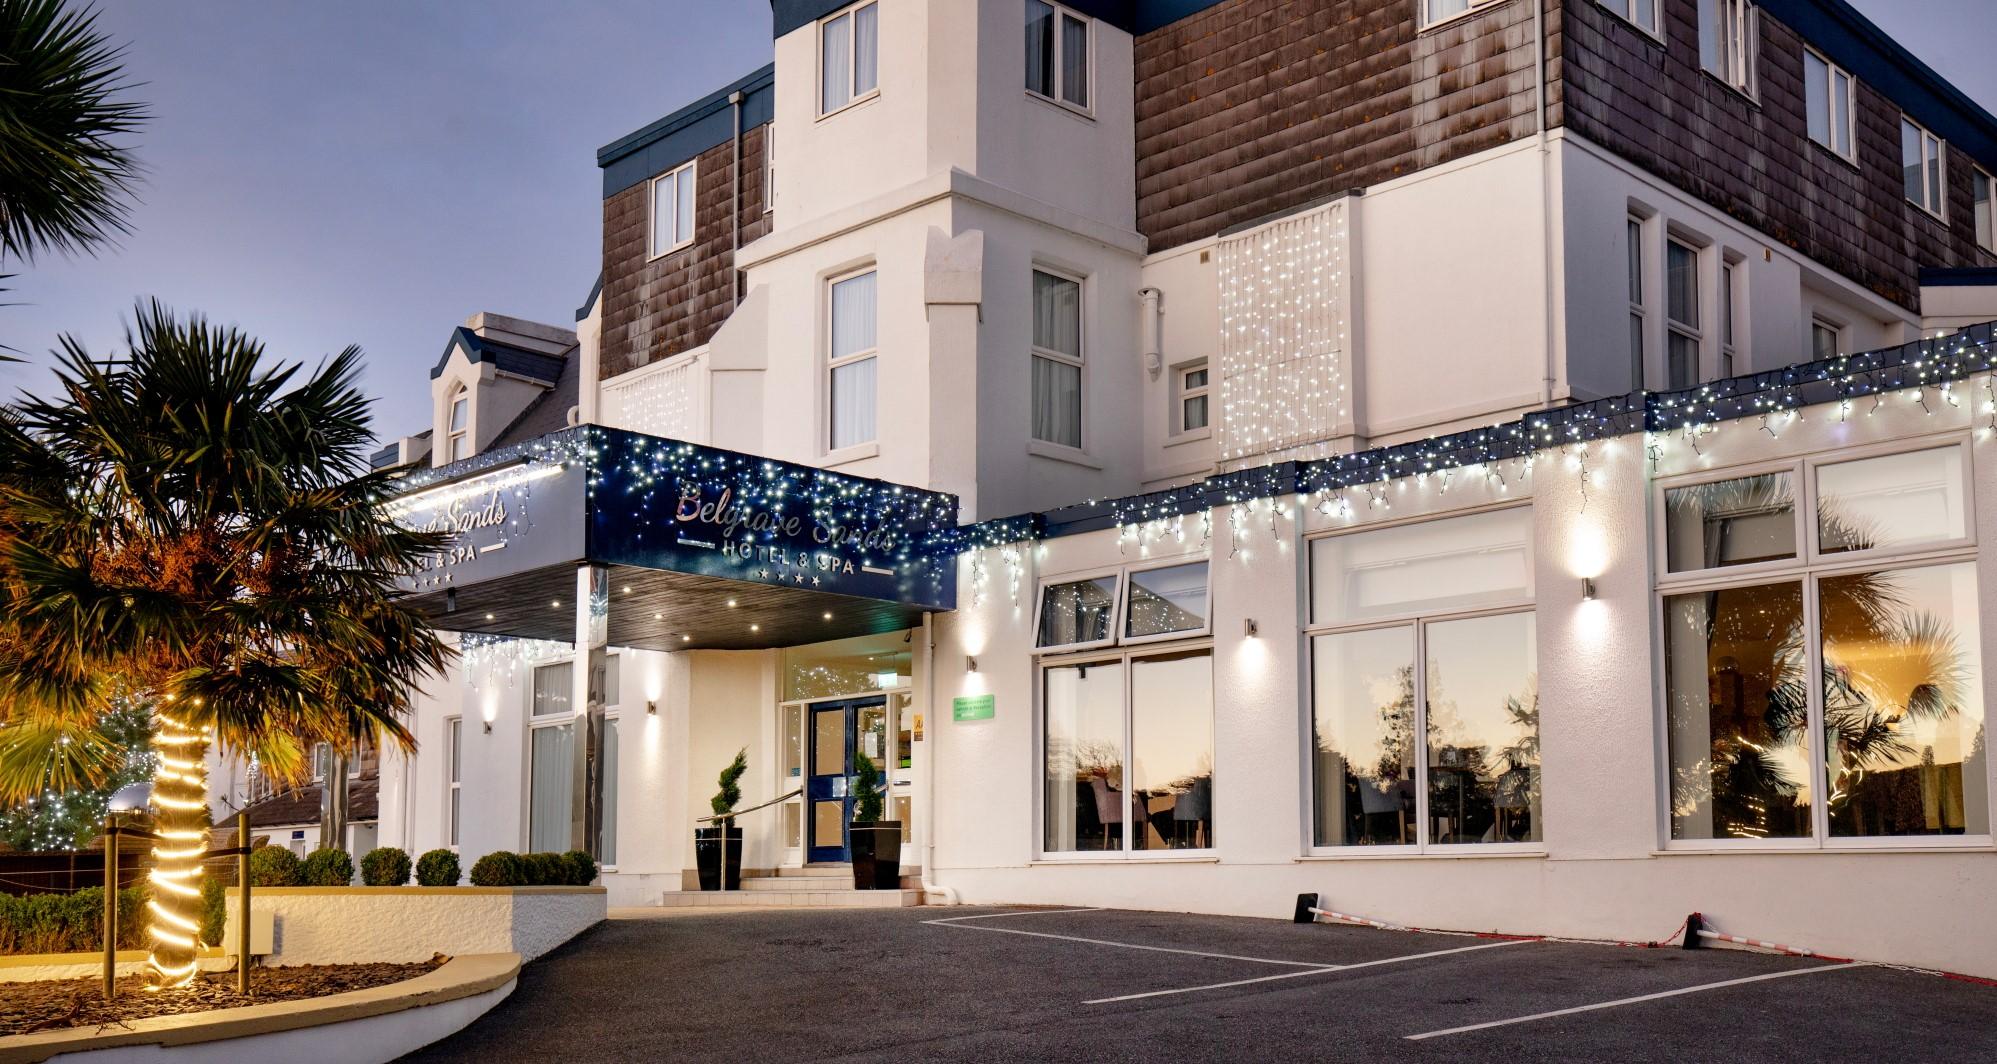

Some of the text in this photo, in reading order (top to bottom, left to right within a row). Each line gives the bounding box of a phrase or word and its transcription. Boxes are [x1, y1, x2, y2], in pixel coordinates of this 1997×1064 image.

[444, 484, 507, 537] Sands
[676, 480, 896, 552] Belgrave Sands
[436, 552, 446, 568] &
[449, 545, 477, 565] SPA
[722, 539, 854, 575] HOTEL & SPA
